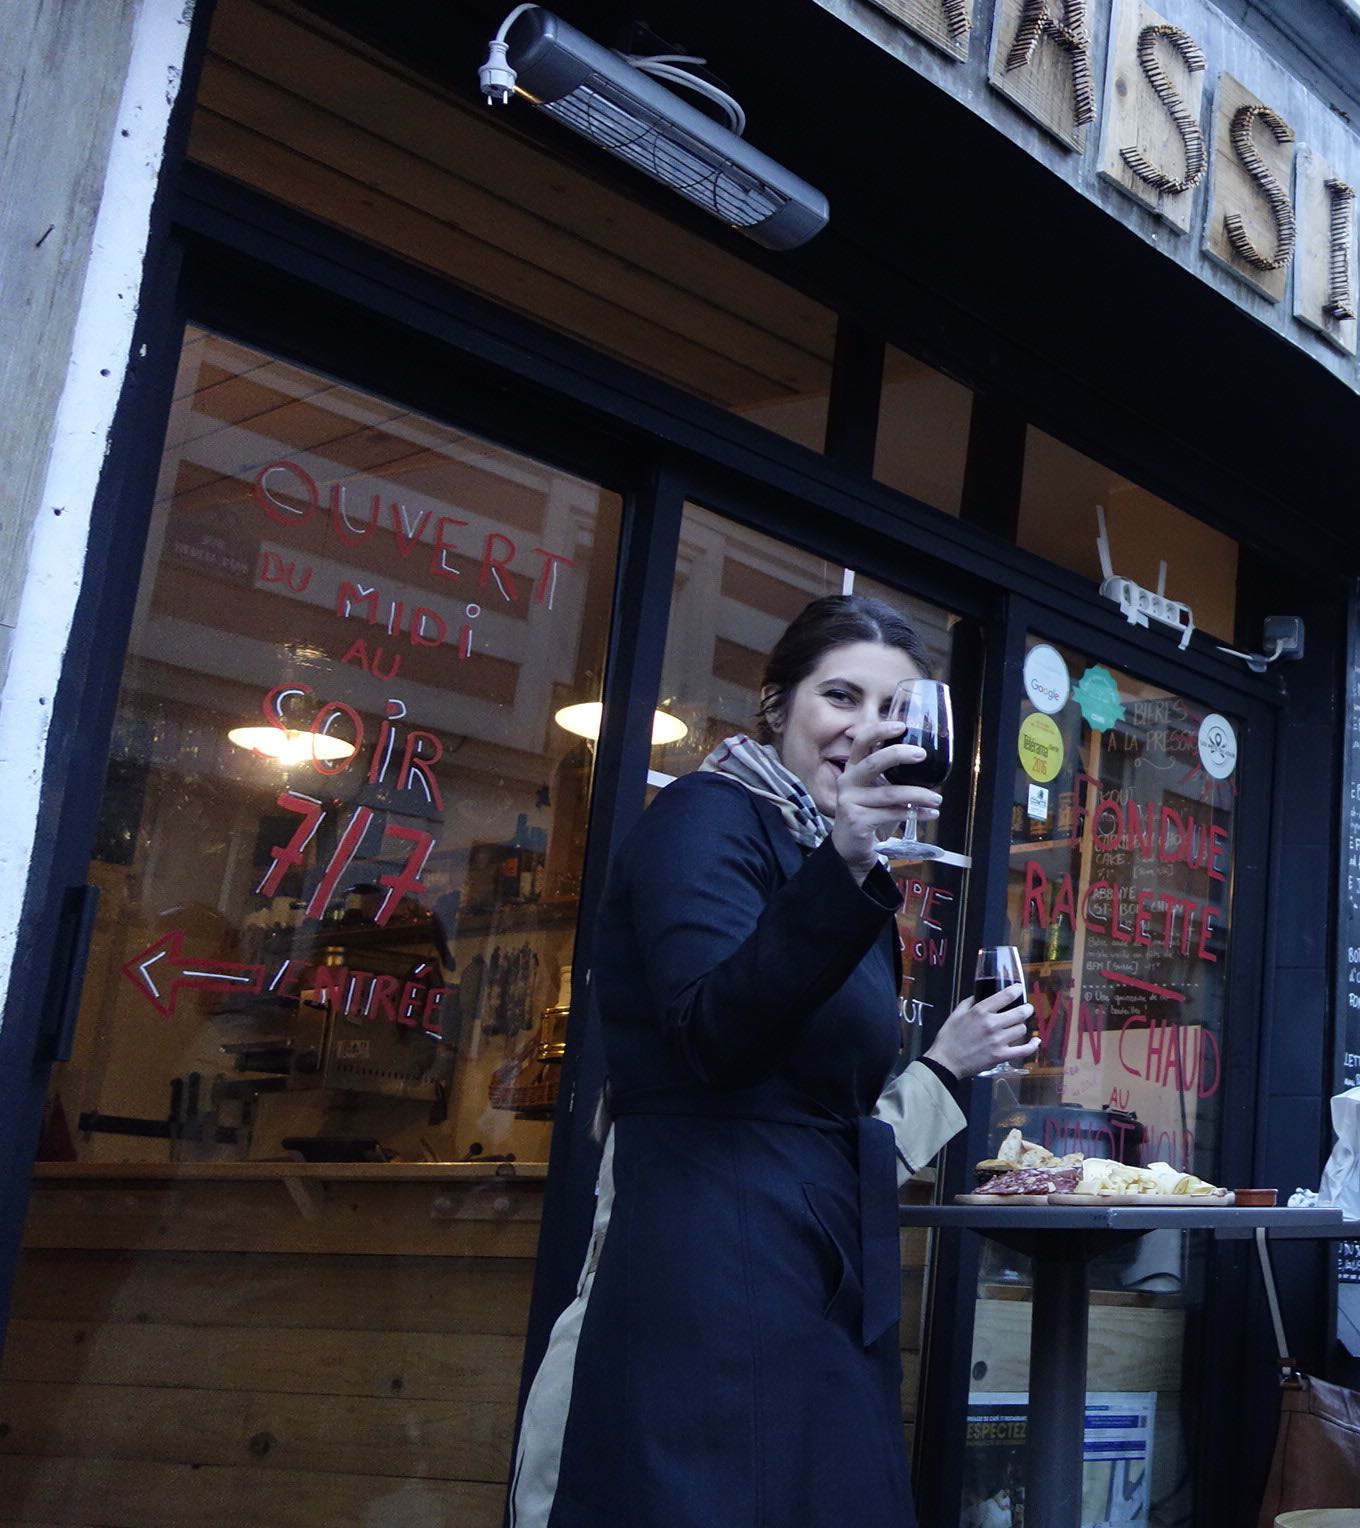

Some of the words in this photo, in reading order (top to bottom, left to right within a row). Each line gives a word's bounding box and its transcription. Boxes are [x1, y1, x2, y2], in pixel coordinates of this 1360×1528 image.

[256, 459, 577, 610] OUVERT
[260, 551, 313, 593] DU
[342, 638, 402, 682] AU
[1031, 678, 1060, 702] Google
[256, 790, 436, 927] 7/7
[1070, 773, 1230, 882] FONDUE
[1023, 859, 1221, 962] RACLETTE
[272, 958, 454, 1040] ENTRÉE
[1109, 1086, 1131, 1109] AU
[1119, 1014, 1222, 1098] CHAUD
